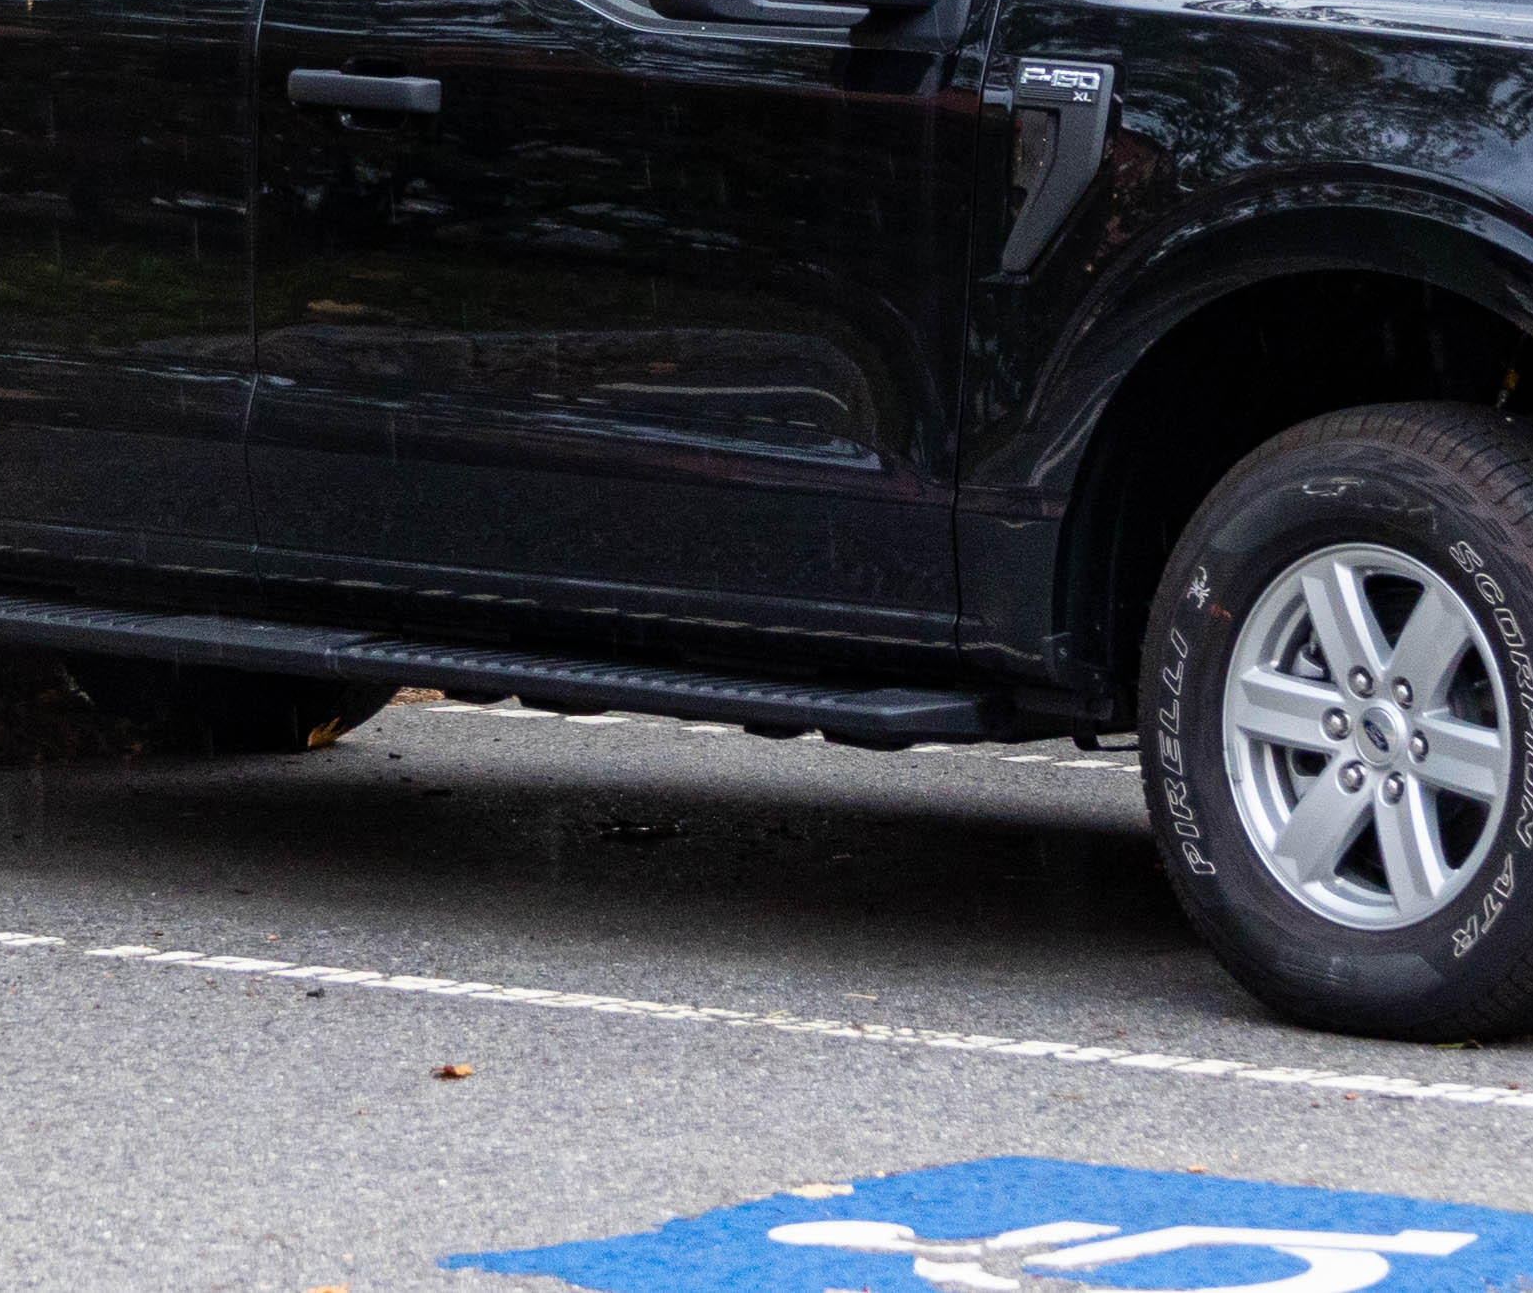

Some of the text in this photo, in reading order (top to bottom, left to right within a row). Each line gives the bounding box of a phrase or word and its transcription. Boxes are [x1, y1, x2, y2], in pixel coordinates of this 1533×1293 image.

[1020, 67, 1100, 91] F-150
[1073, 91, 1092, 102] XL
[1158, 627, 1216, 875] PIRELLI
[1450, 852, 1516, 959] ATR
